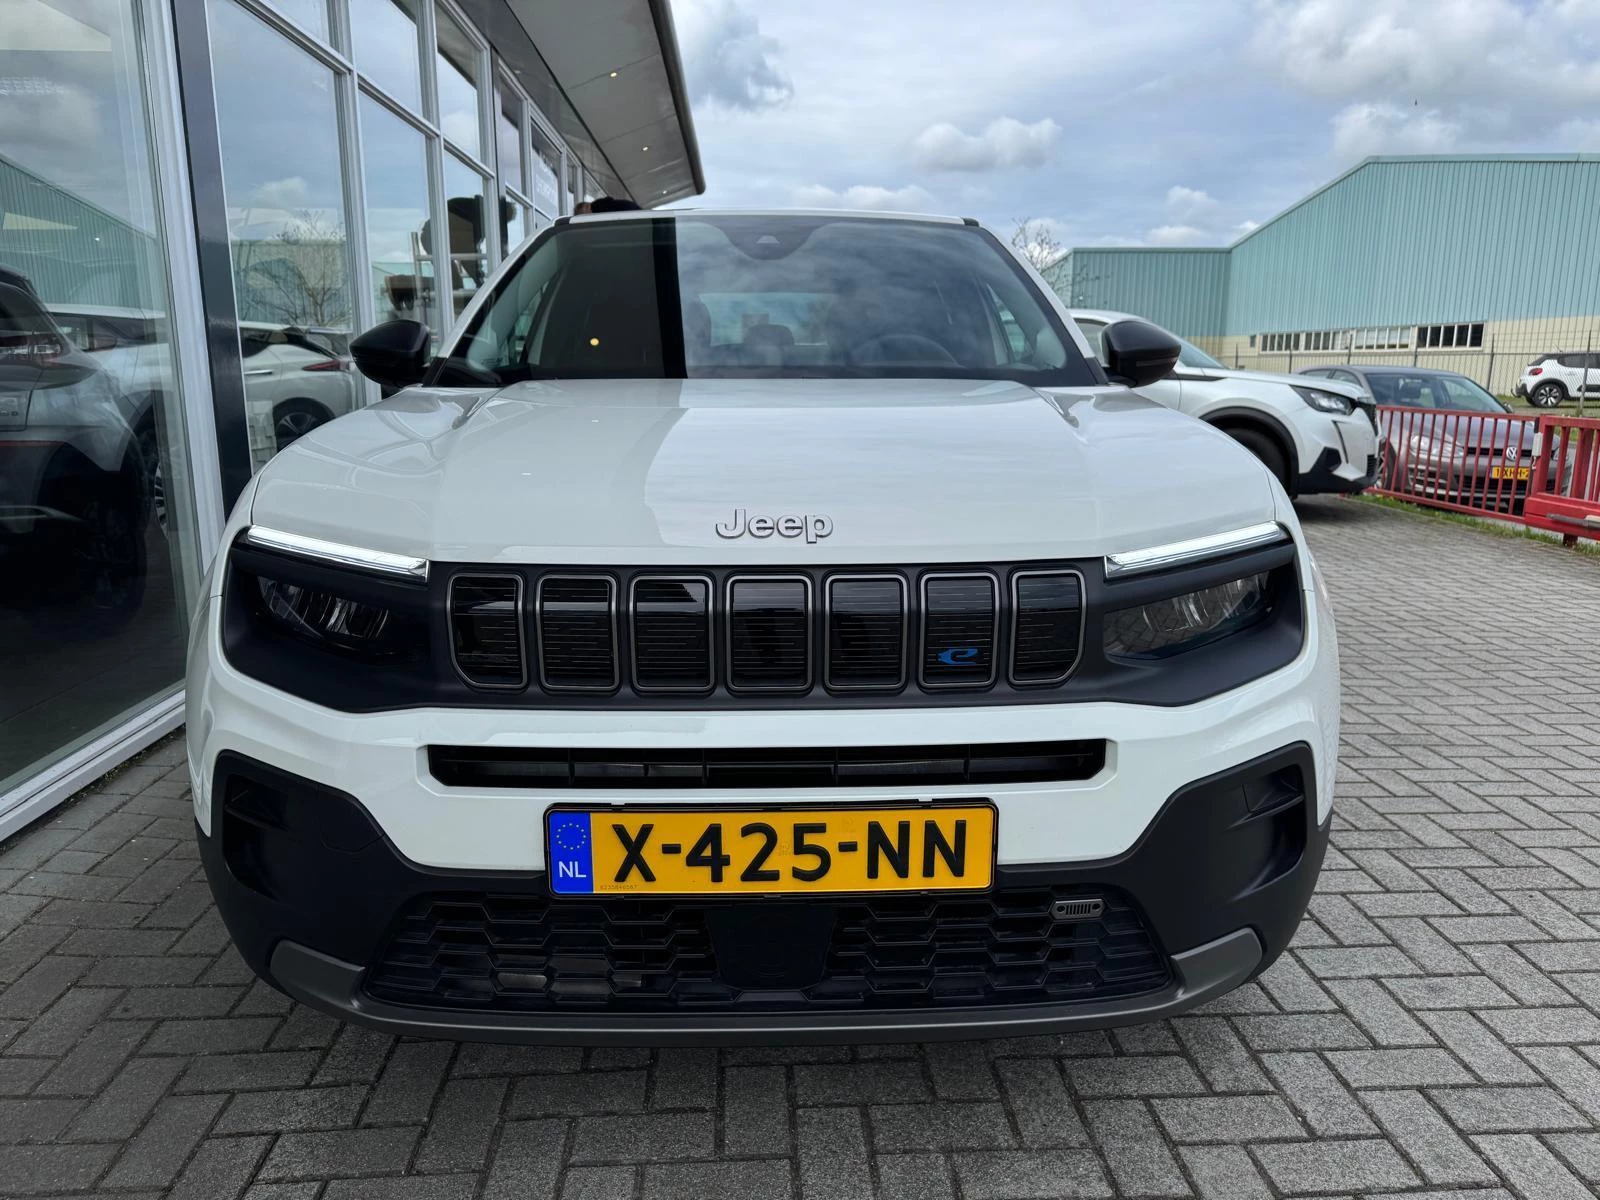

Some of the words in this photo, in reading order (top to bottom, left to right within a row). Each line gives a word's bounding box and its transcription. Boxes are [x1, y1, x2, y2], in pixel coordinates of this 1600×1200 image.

[715, 508, 834, 545] Jeep
[558, 860, 587, 878] NL
[611, 819, 967, 883] X-425-NN
